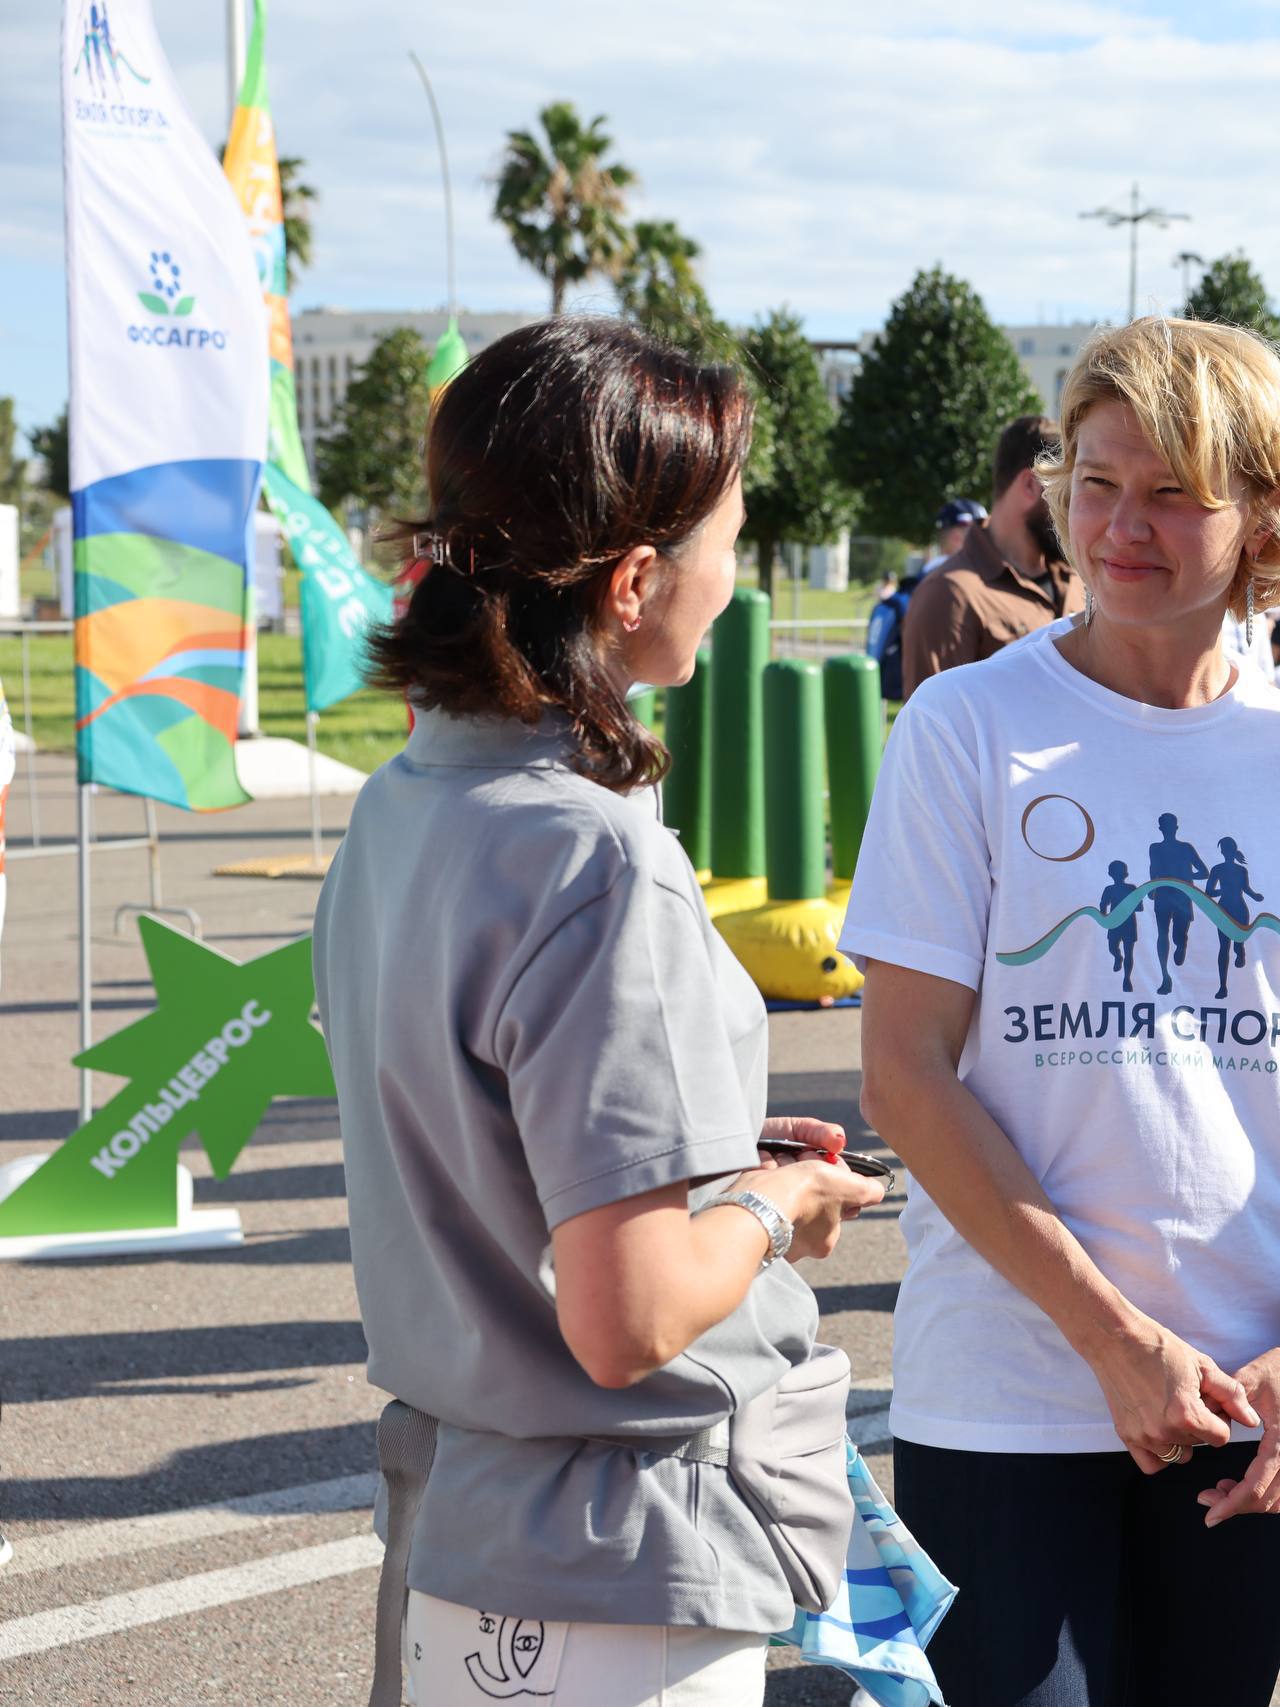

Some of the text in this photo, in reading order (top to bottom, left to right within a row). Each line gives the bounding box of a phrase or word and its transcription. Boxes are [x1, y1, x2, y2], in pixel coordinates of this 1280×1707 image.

[126, 324, 227, 351] ФОСАГРО
[1003, 1001, 1156, 1043] ЗЕМЛЯ
[1034, 1046, 1204, 1068] ВСЕРОССИЙСКИЙ
[89, 999, 273, 1180] КОЛЬЦЕБРОС
